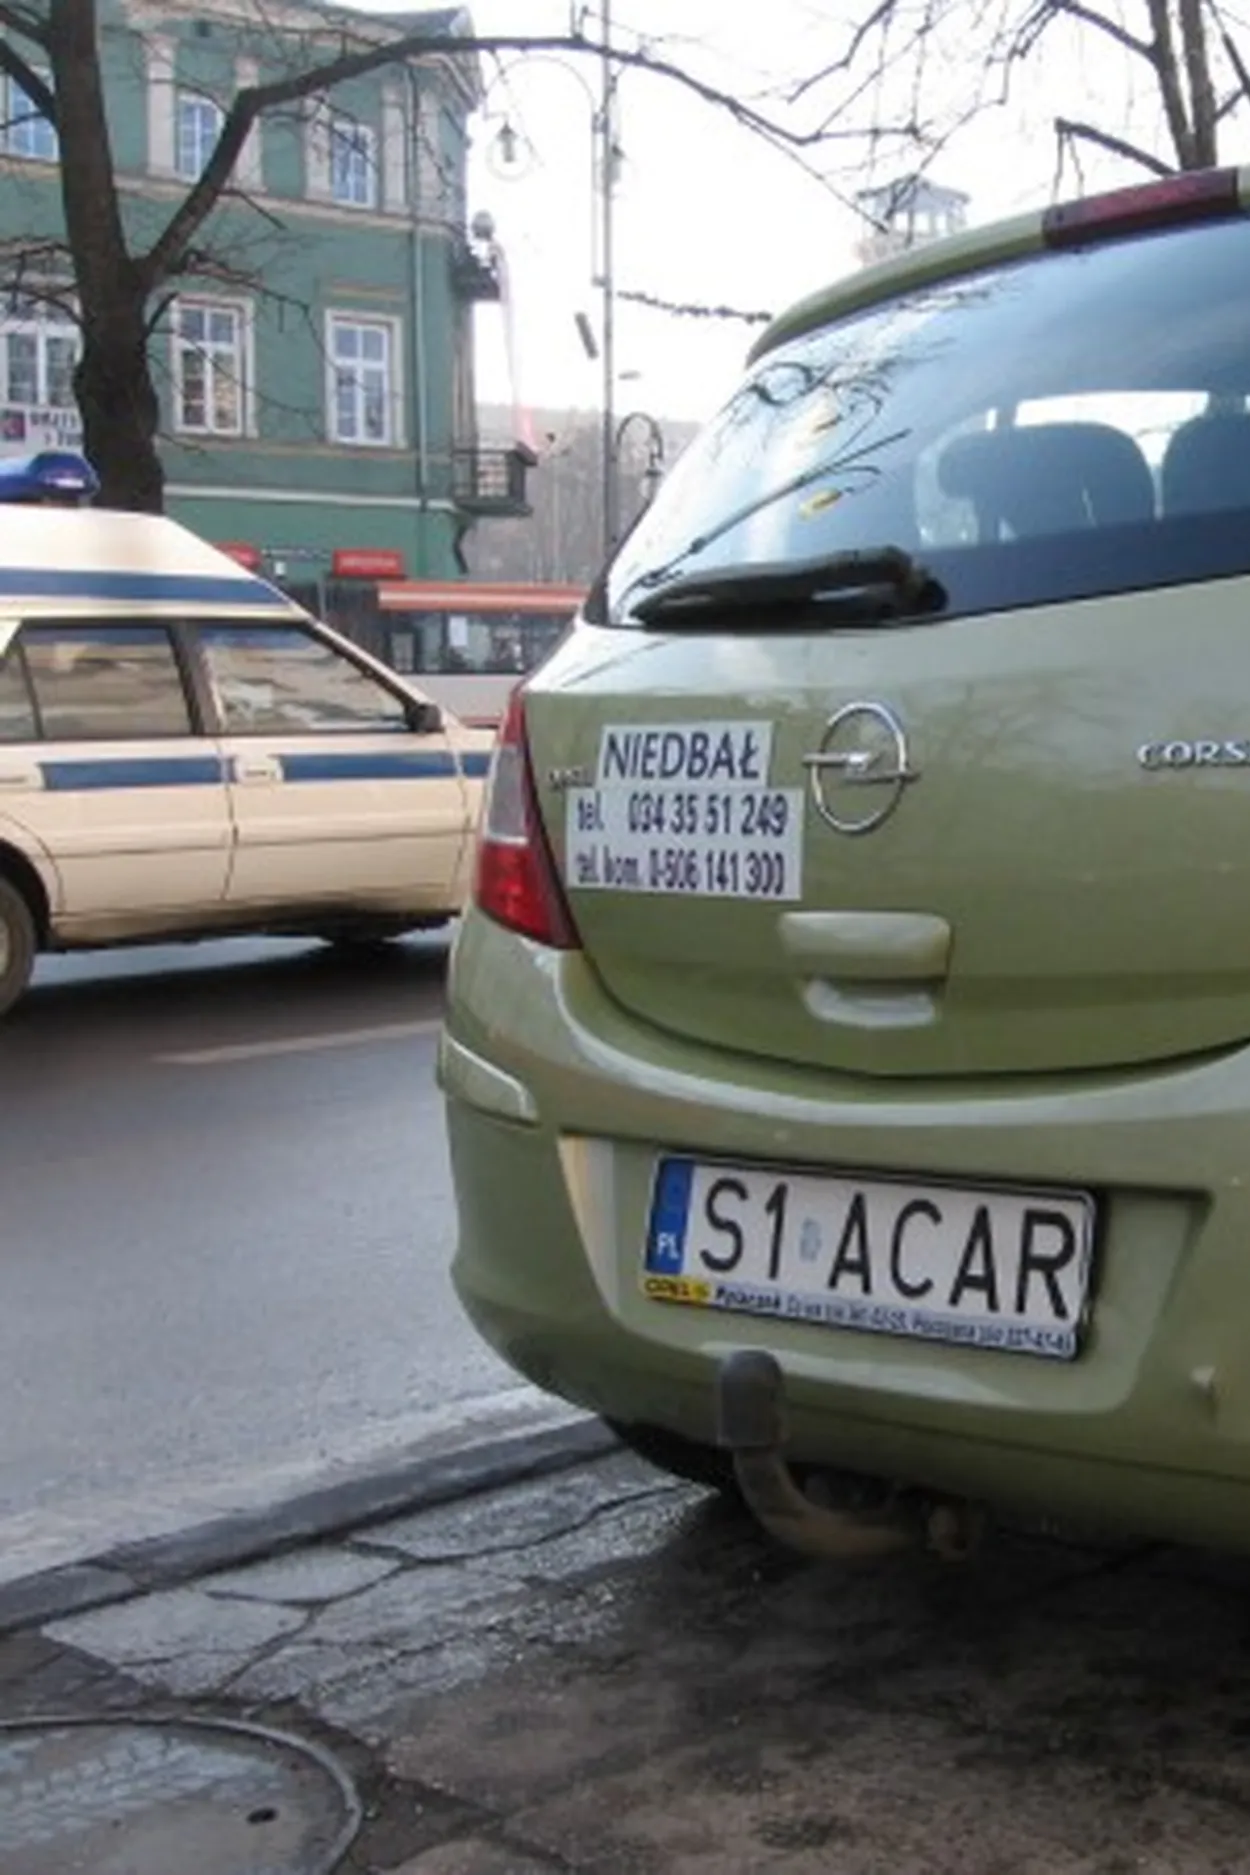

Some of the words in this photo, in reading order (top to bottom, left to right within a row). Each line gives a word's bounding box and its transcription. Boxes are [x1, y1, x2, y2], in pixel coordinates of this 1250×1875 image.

[603, 731, 759, 779] NIEDBAŁ
[628, 792, 665, 834] 034
[671, 793, 697, 835] 35
[706, 794, 731, 835] 51
[741, 793, 788, 837] 249
[706, 850, 738, 892] 141
[746, 851, 785, 894] 300
[657, 1231, 680, 1259] PL
[699, 1177, 789, 1280] S1
[828, 1191, 1076, 1320] ACAR
